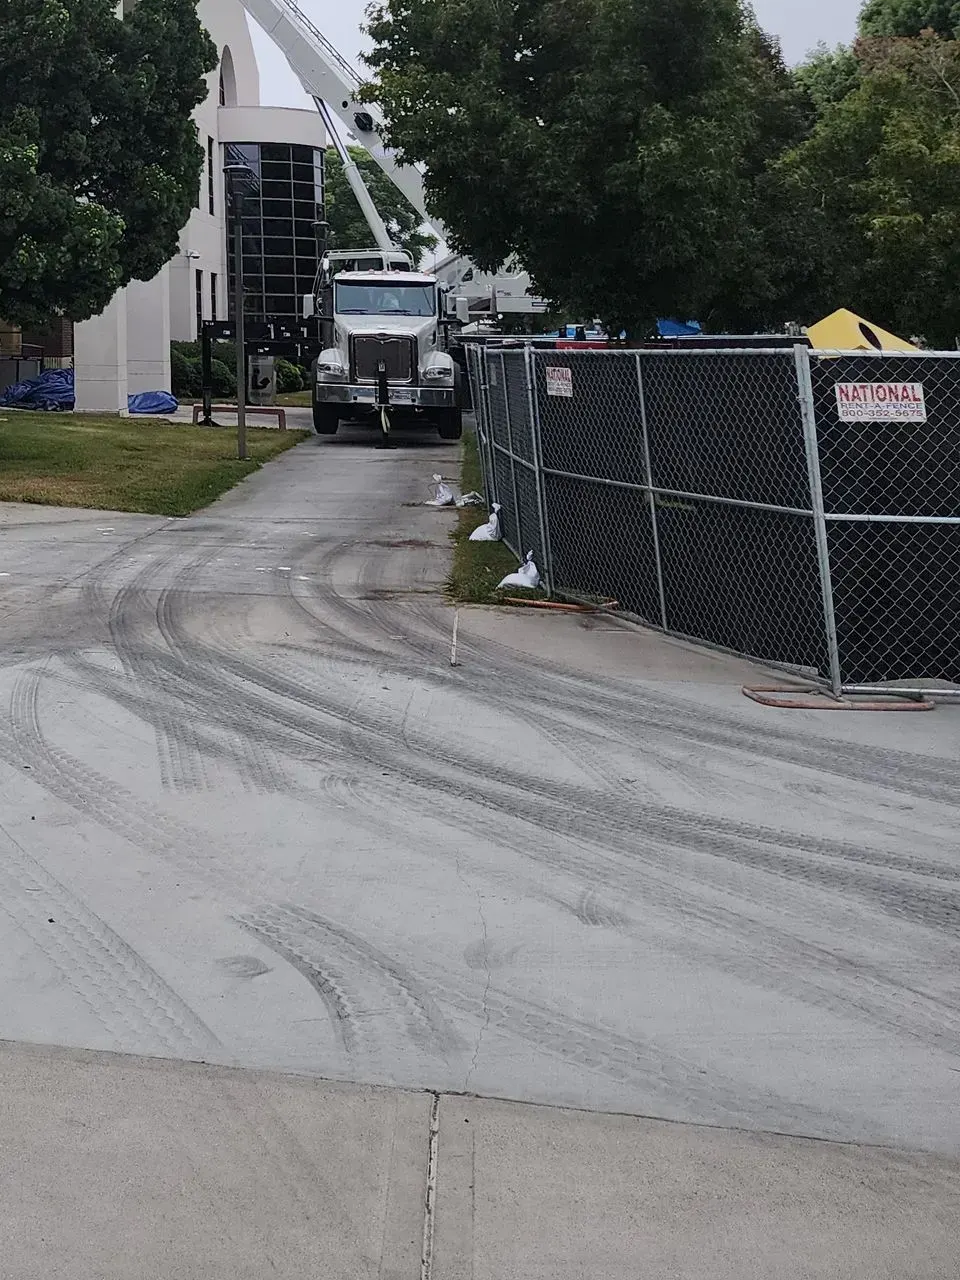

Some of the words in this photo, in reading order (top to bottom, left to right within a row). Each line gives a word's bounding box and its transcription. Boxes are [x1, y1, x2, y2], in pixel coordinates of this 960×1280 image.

[838, 384, 921, 402] NATIONAL
[840, 402, 923, 410] RENT-A-FENCE
[841, 409, 924, 417] 800-352-5675
